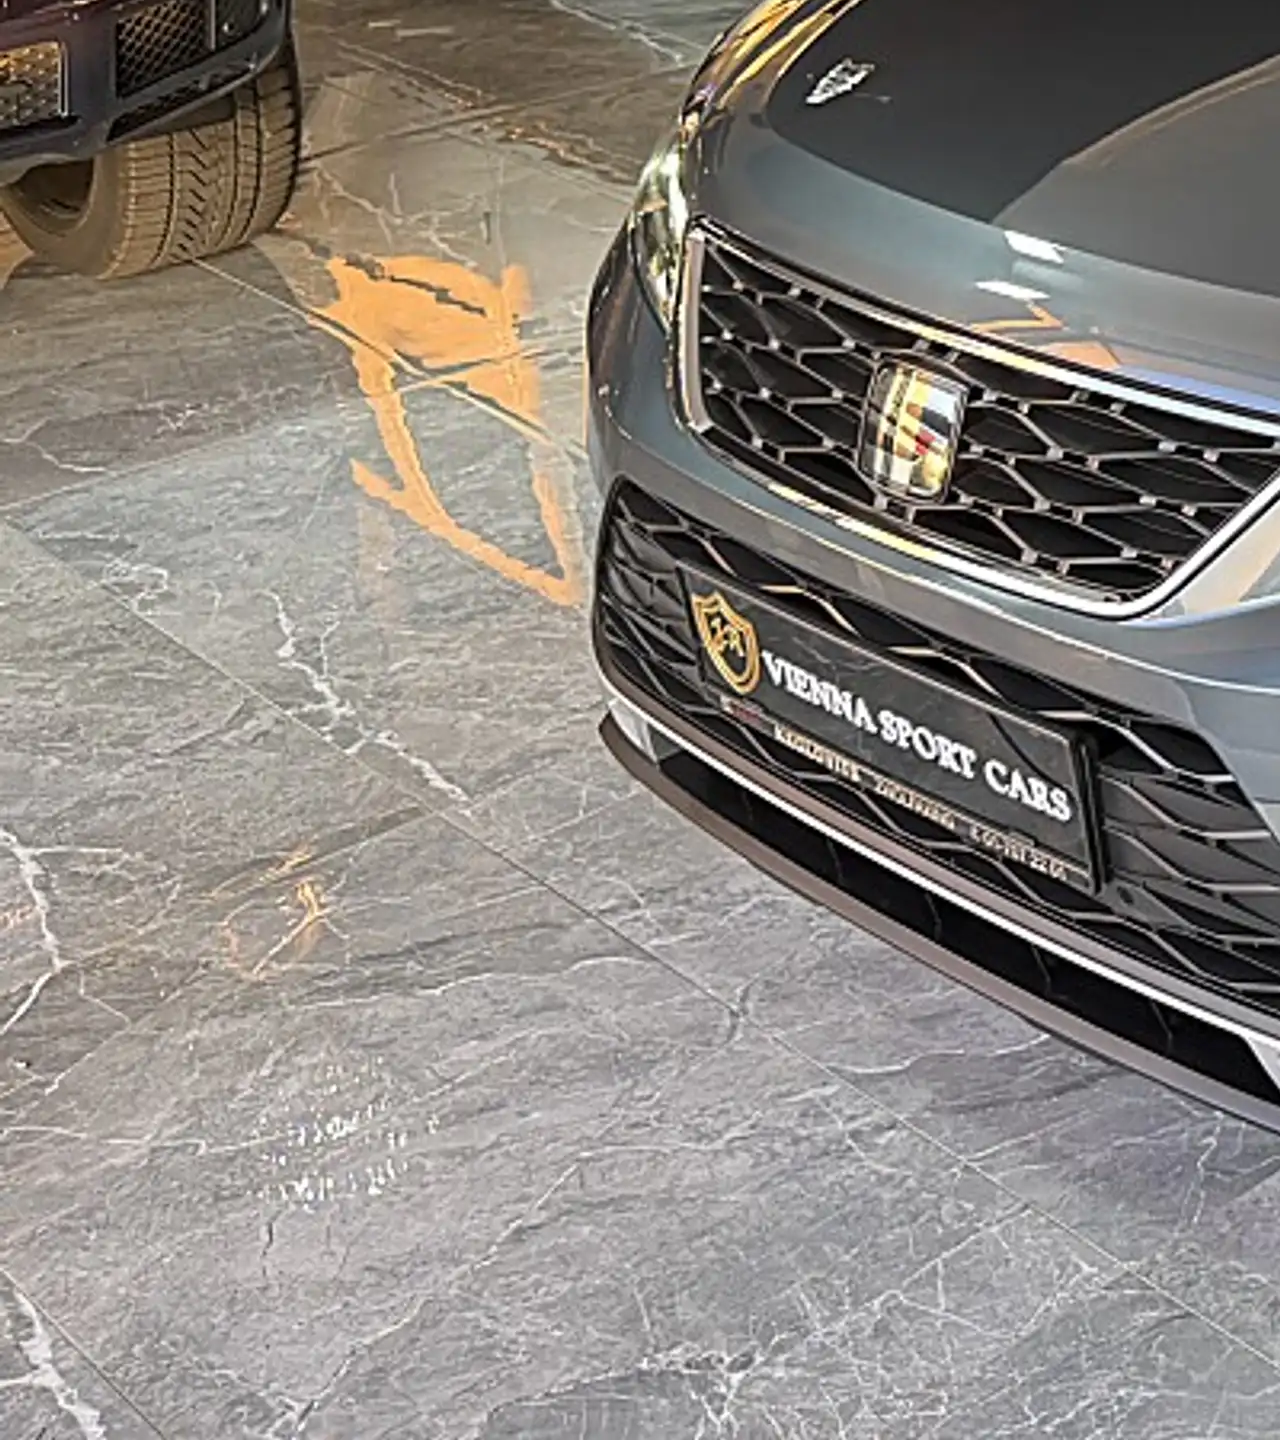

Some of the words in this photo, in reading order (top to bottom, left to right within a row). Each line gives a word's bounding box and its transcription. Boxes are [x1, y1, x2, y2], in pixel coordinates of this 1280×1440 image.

[762, 650, 878, 735] VIENNA
[879, 709, 977, 780] SPORT
[984, 758, 1073, 823] CARS
